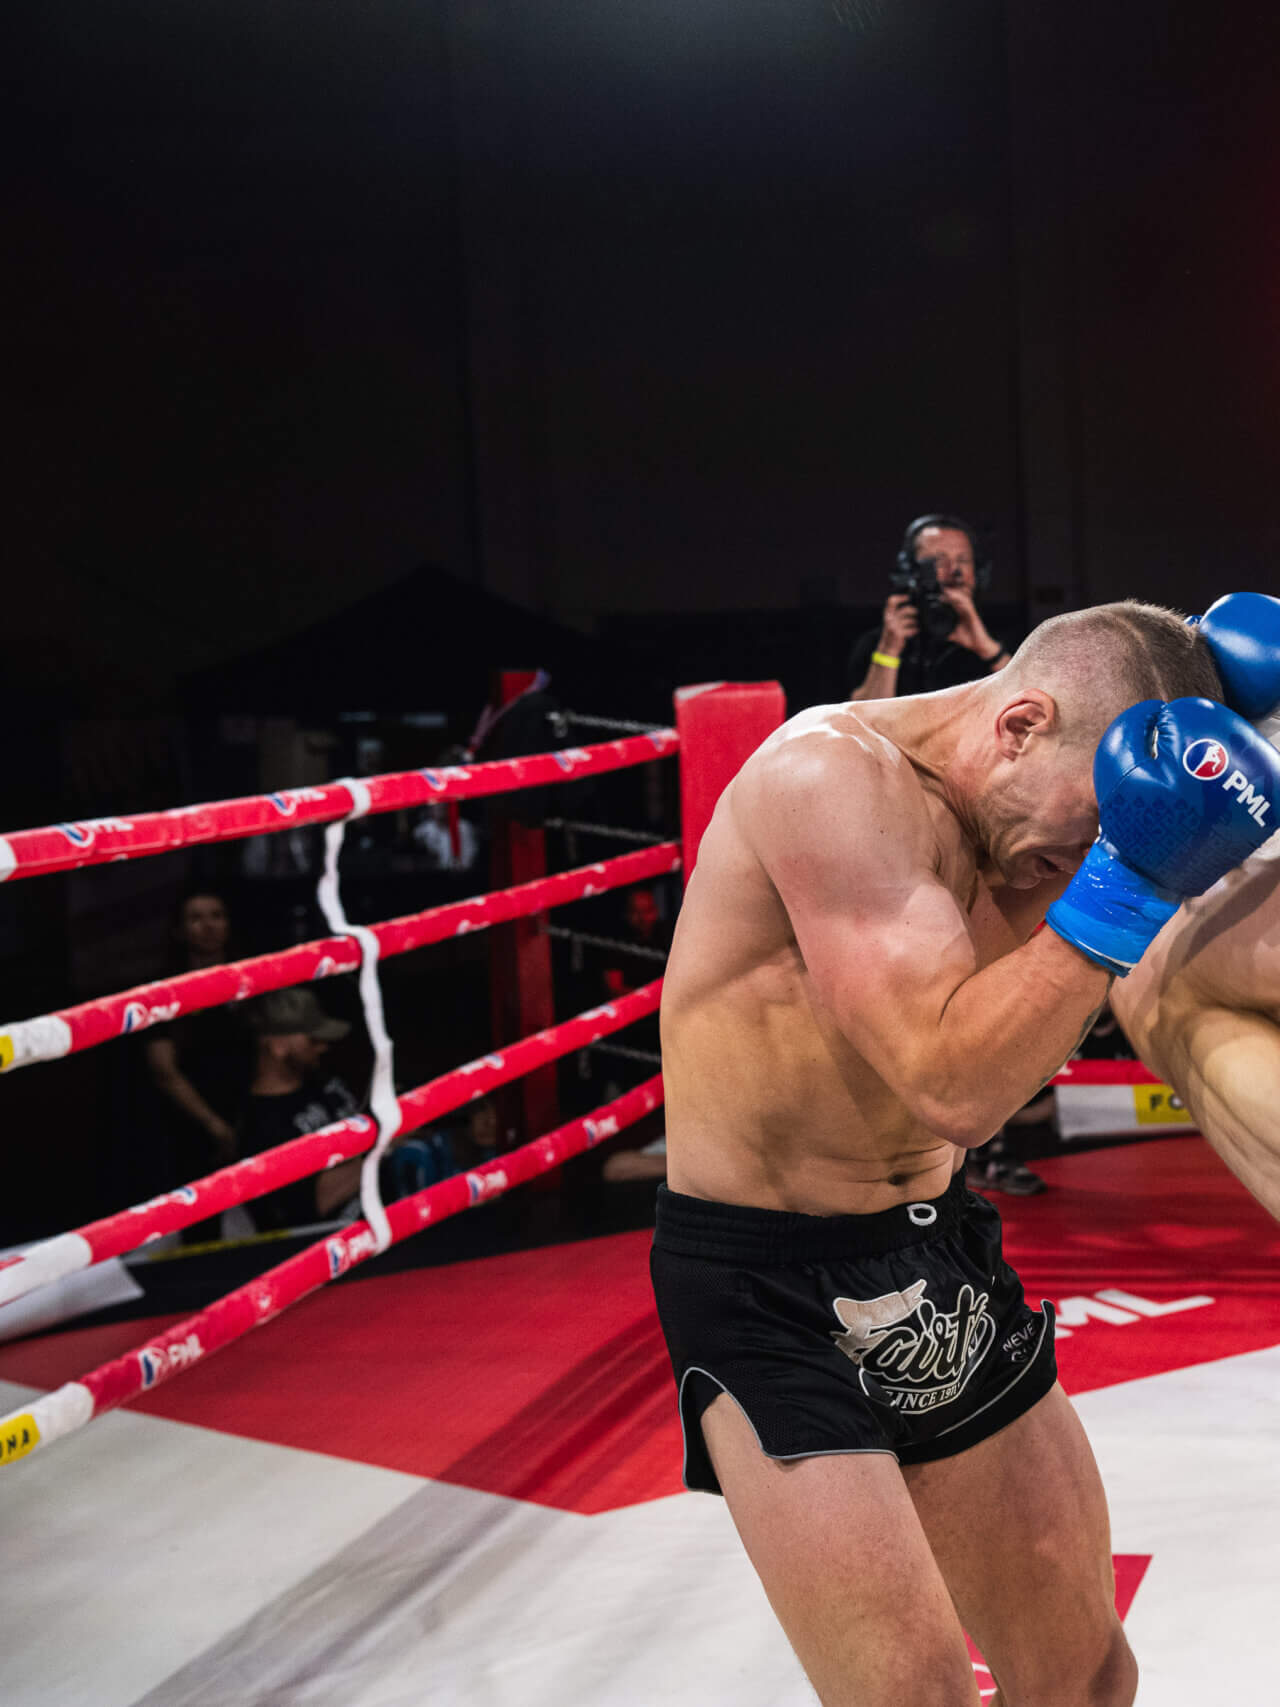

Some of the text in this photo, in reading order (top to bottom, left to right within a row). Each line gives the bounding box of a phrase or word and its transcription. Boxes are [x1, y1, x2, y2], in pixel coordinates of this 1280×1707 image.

[1222, 770, 1271, 827] PML
[1003, 1319, 1036, 1352] NEVE
[1055, 1289, 1216, 1340] ML
